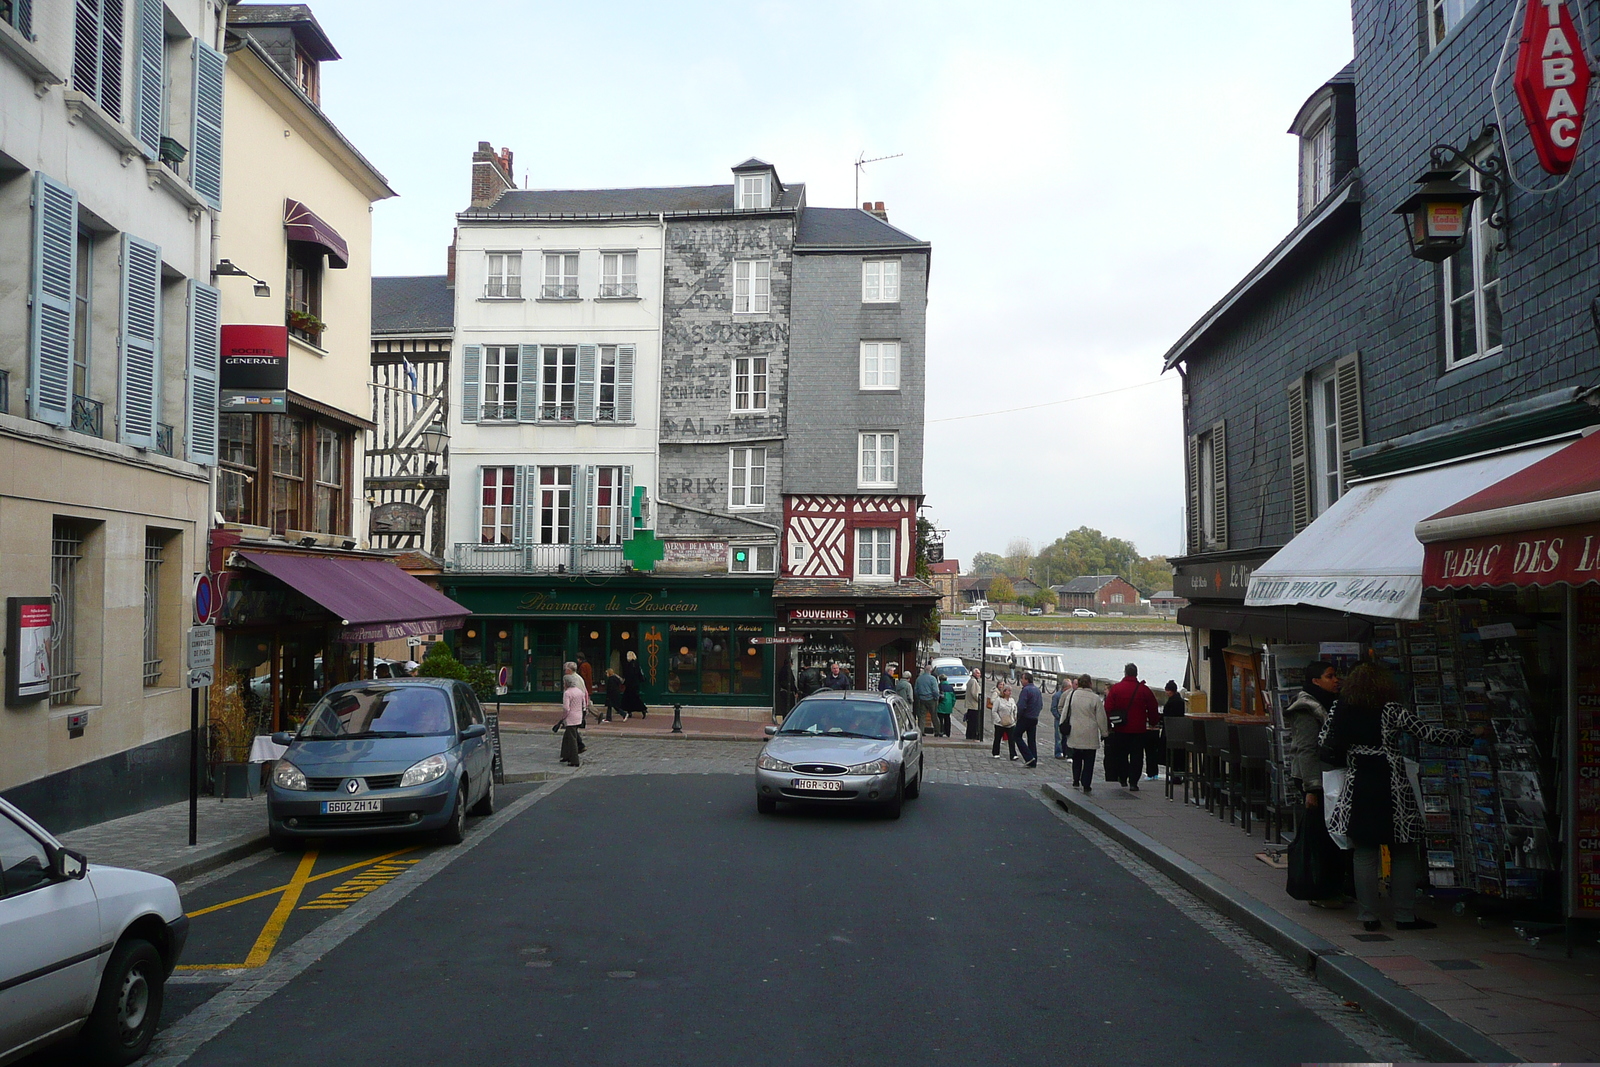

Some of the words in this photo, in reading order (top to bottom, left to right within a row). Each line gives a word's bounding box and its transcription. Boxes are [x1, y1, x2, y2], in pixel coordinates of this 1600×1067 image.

[1541, 0, 1577, 148] TABAC
[1432, 215, 1460, 224] Kodak
[713, 424, 730, 435] DE
[689, 542, 697, 550] DE
[698, 542, 708, 550] LA
[709, 542, 724, 550] MER
[1442, 544, 1502, 579] TABAC
[1512, 537, 1564, 575] DES
[1229, 564, 1239, 588] Le
[1248, 581, 1290, 599] ATELIER
[1286, 581, 1337, 599] PHOTO
[1335, 578, 1407, 607] Lefebvre
[517, 591, 597, 611] Pharmacie
[605, 595, 620, 611] du
[626, 592, 699, 612] Passocéan
[795, 609, 850, 619] SOUVENIRS
[1579, 766, 1600, 778] CH
[800, 780, 840, 790] HGR-303
[328, 802, 352, 812] 6602
[354, 801, 366, 811] ZH
[367, 801, 378, 810] 14
